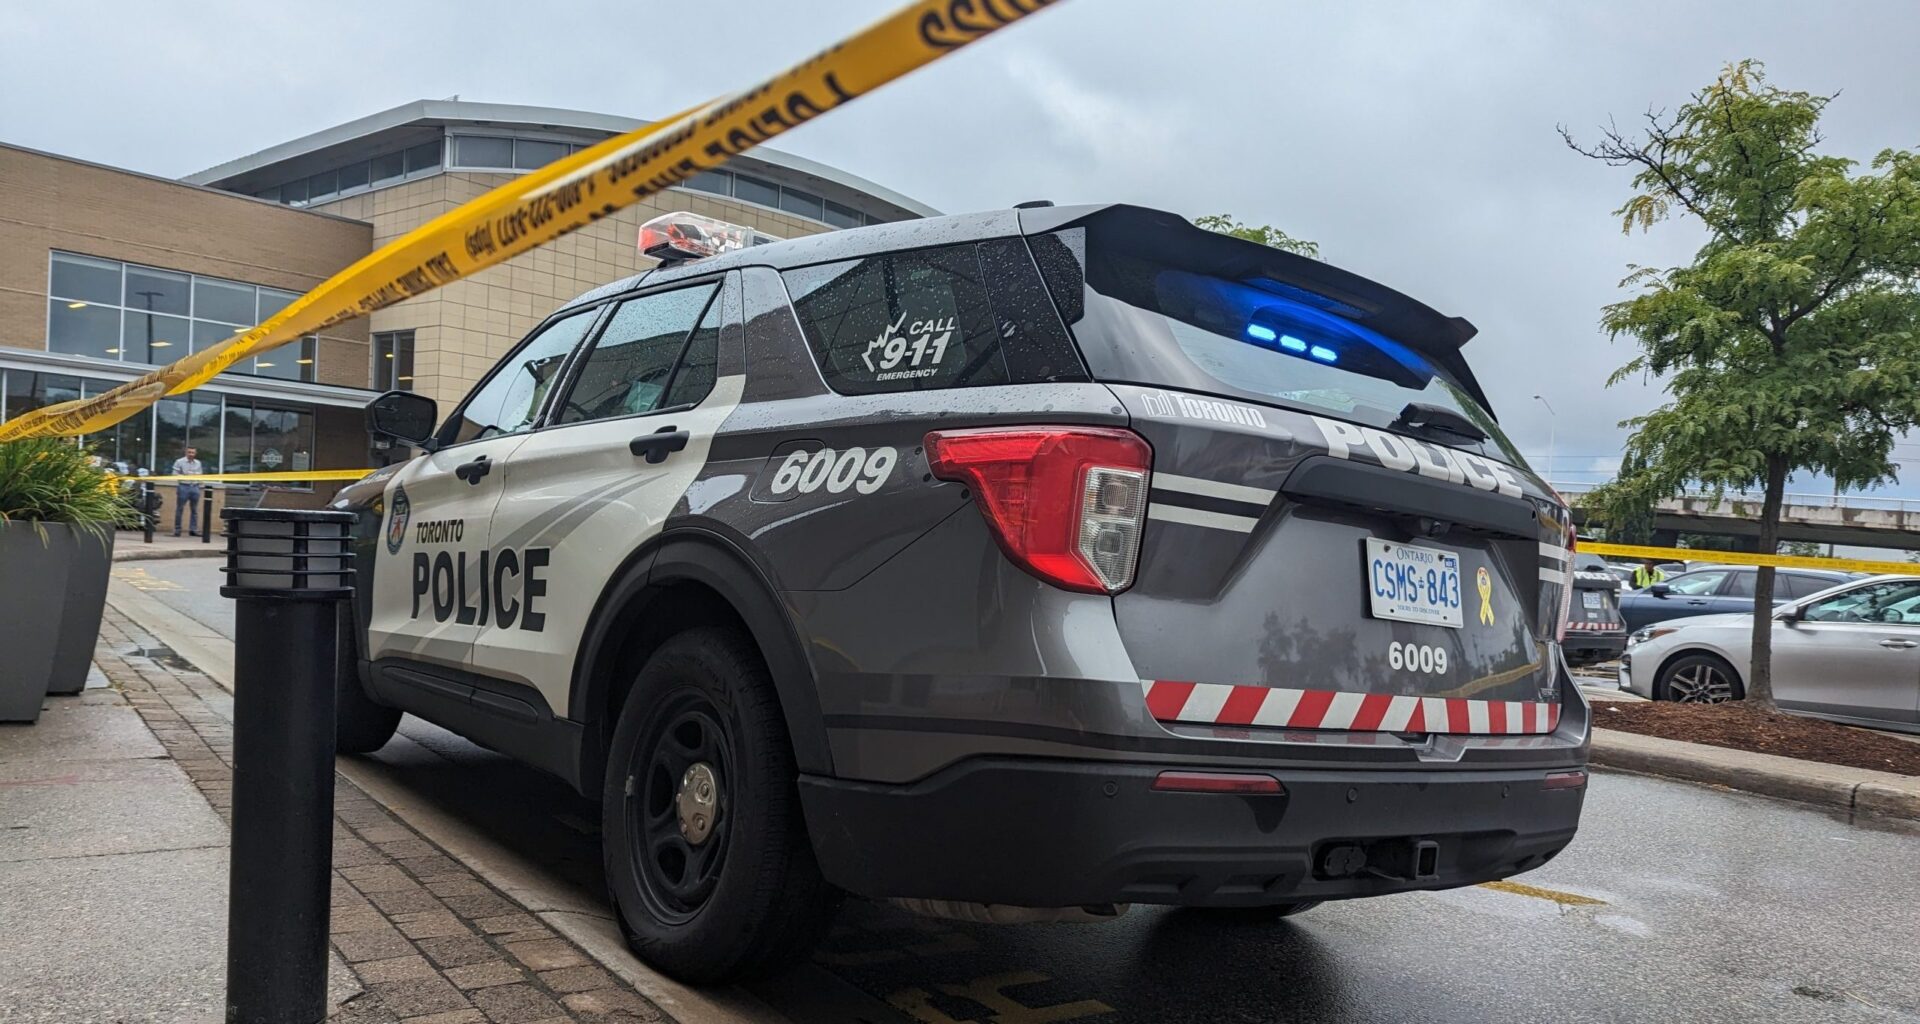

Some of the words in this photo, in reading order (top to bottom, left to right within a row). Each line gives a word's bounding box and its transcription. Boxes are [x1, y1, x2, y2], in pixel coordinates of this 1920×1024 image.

[909, 317, 955, 335] CALL
[880, 331, 952, 369] 9-1-1
[877, 368, 938, 381] EMERGENCY
[1170, 393, 1266, 429] TORONTO
[771, 446, 898, 495] 6009
[1311, 416, 1523, 499] POLICE
[416, 518, 464, 543] TORONTO
[1396, 547, 1433, 564] ONTARIO
[411, 547, 550, 632] POLICE
[1388, 640, 1448, 676] 6009
